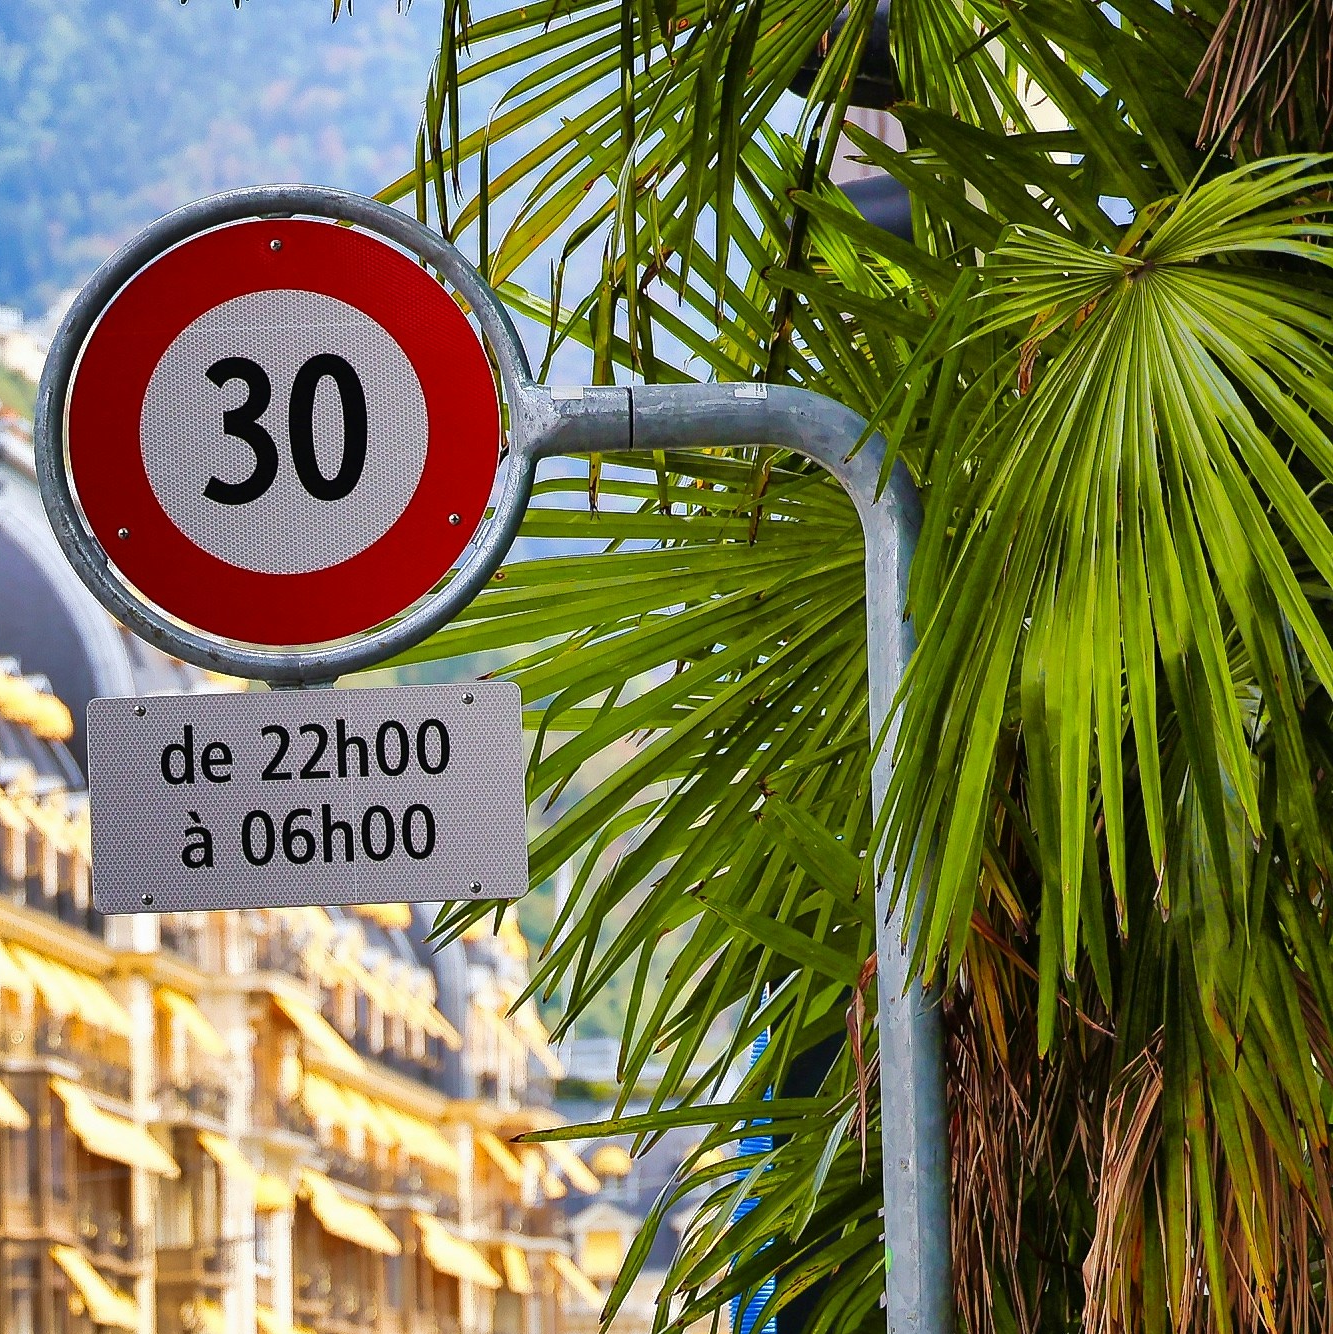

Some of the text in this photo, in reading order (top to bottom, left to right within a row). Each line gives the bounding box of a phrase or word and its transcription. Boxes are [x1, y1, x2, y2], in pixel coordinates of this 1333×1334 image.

[202, 353, 368, 506] 30
[159, 717, 451, 786] de 22h00
[181, 802, 437, 870] à 06h00
